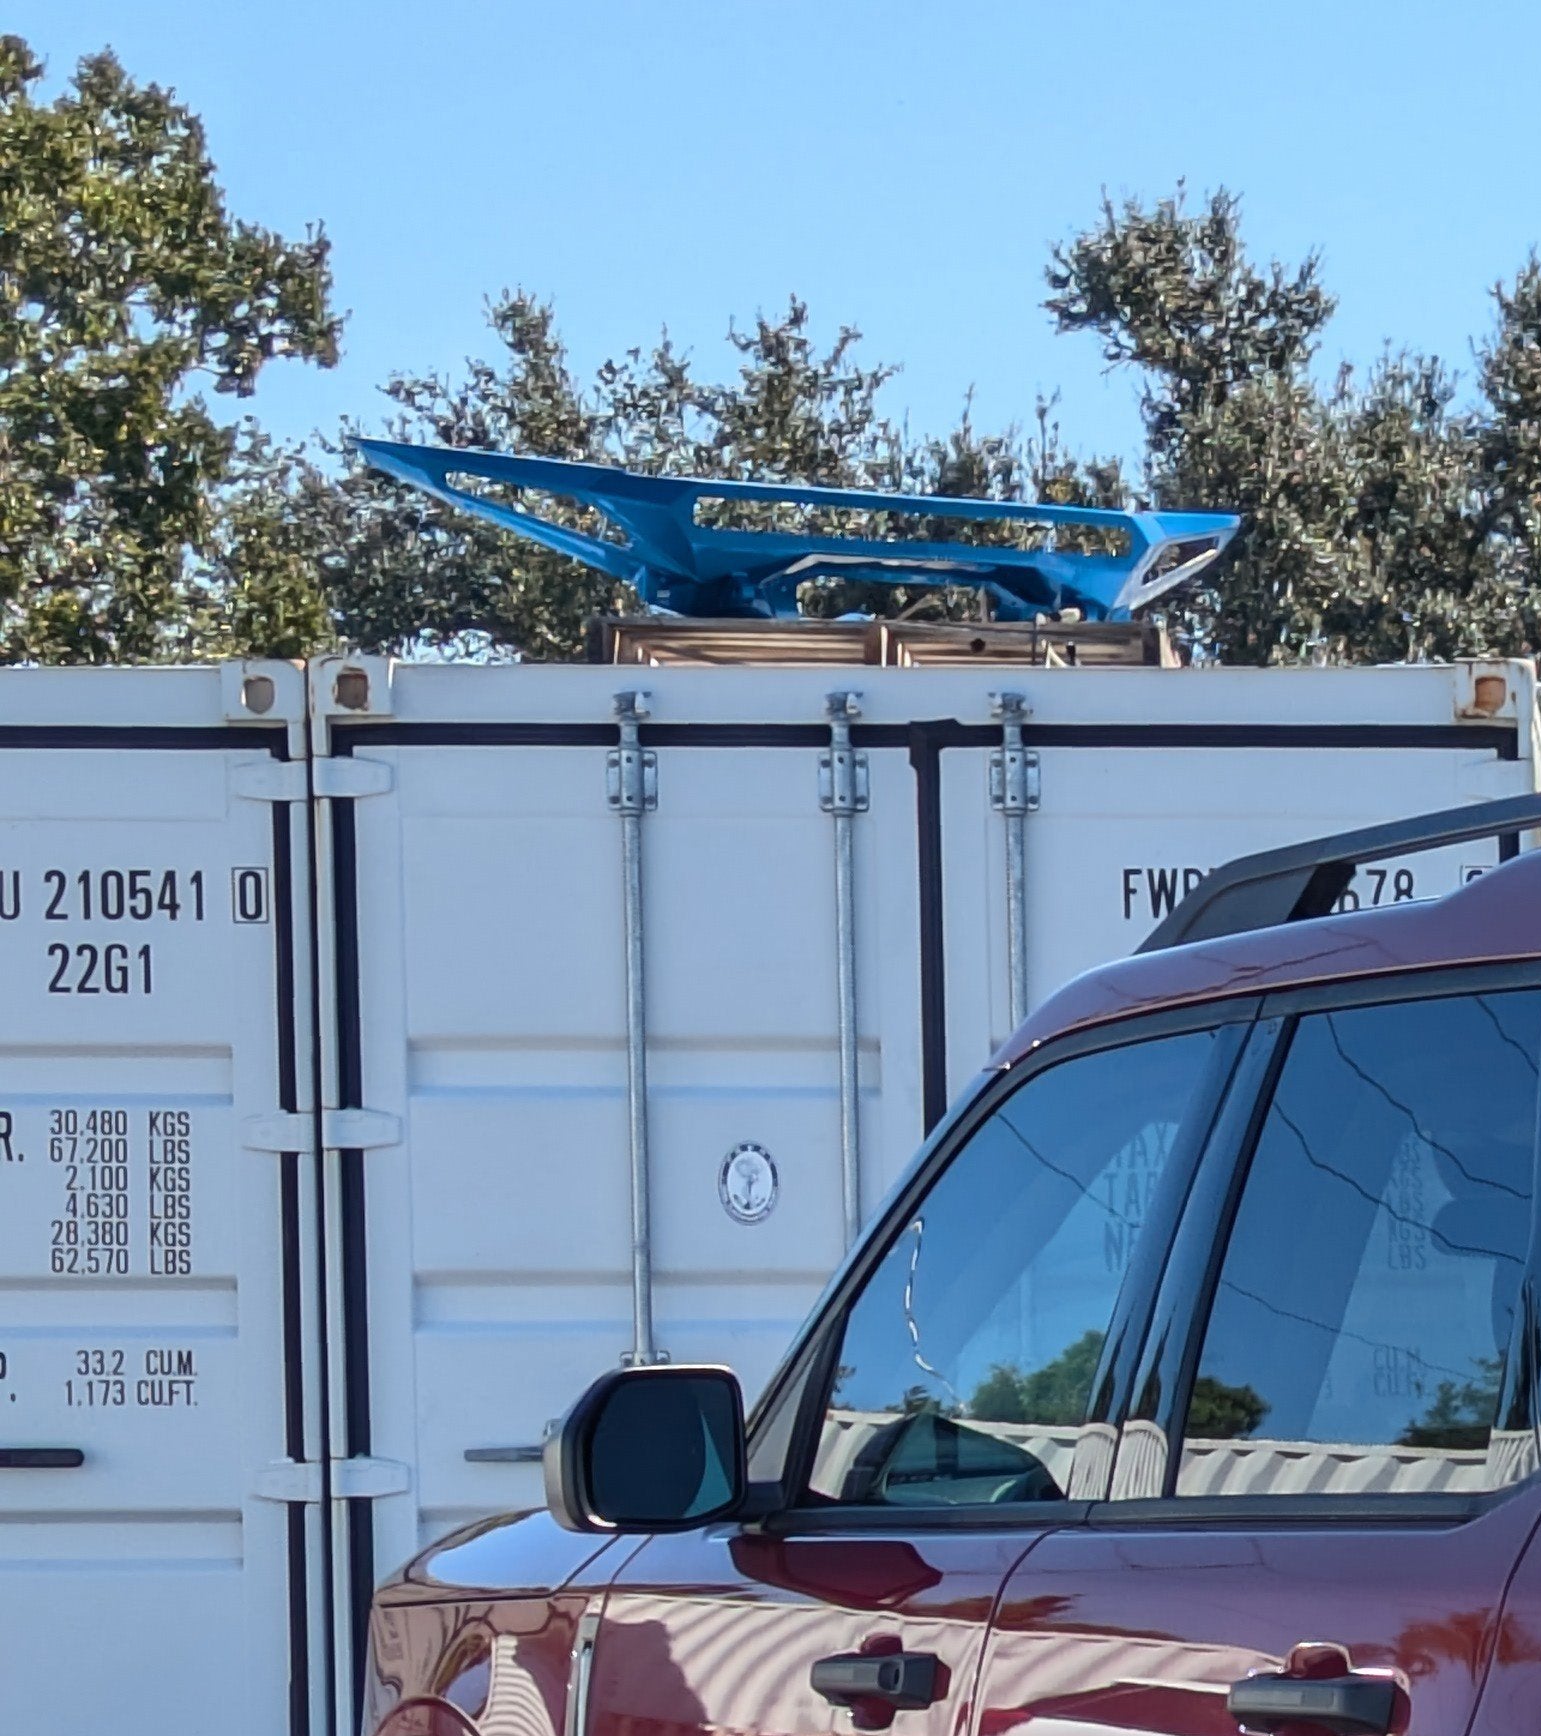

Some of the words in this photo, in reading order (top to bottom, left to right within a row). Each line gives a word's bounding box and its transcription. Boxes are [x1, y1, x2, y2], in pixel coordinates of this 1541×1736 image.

[44, 869, 205, 921] 210541
[239, 870, 263, 920] 0
[48, 943, 152, 994] 22G1
[149, 1111, 190, 1137] KGS
[149, 1139, 191, 1165] LBS
[150, 1166, 191, 1193] KGS
[150, 1194, 191, 1220] LBS
[150, 1221, 191, 1248] KGS
[150, 1249, 191, 1275] LBS
[76, 1349, 125, 1376] 33.2
